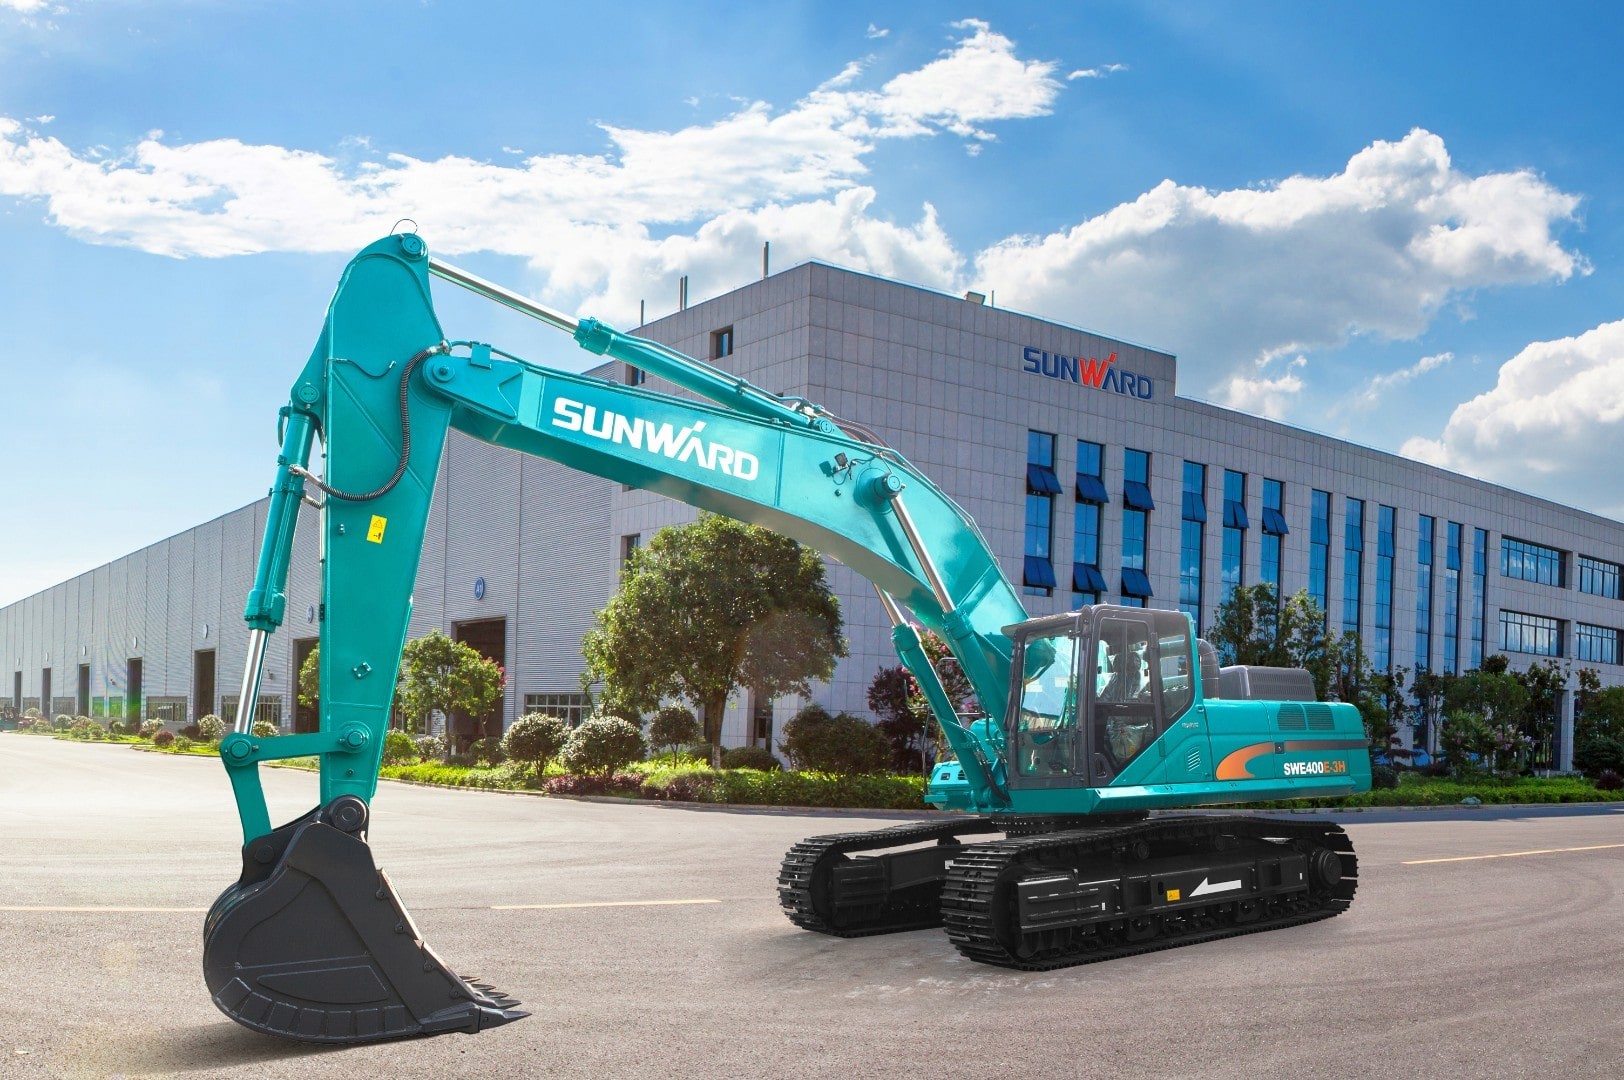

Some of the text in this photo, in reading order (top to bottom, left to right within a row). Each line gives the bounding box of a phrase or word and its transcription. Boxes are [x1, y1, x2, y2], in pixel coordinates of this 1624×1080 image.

[1024, 347, 1152, 400] SUNWARD
[553, 397, 759, 481] SUNWARD
[1283, 761, 1346, 775] SWE400E-3H
